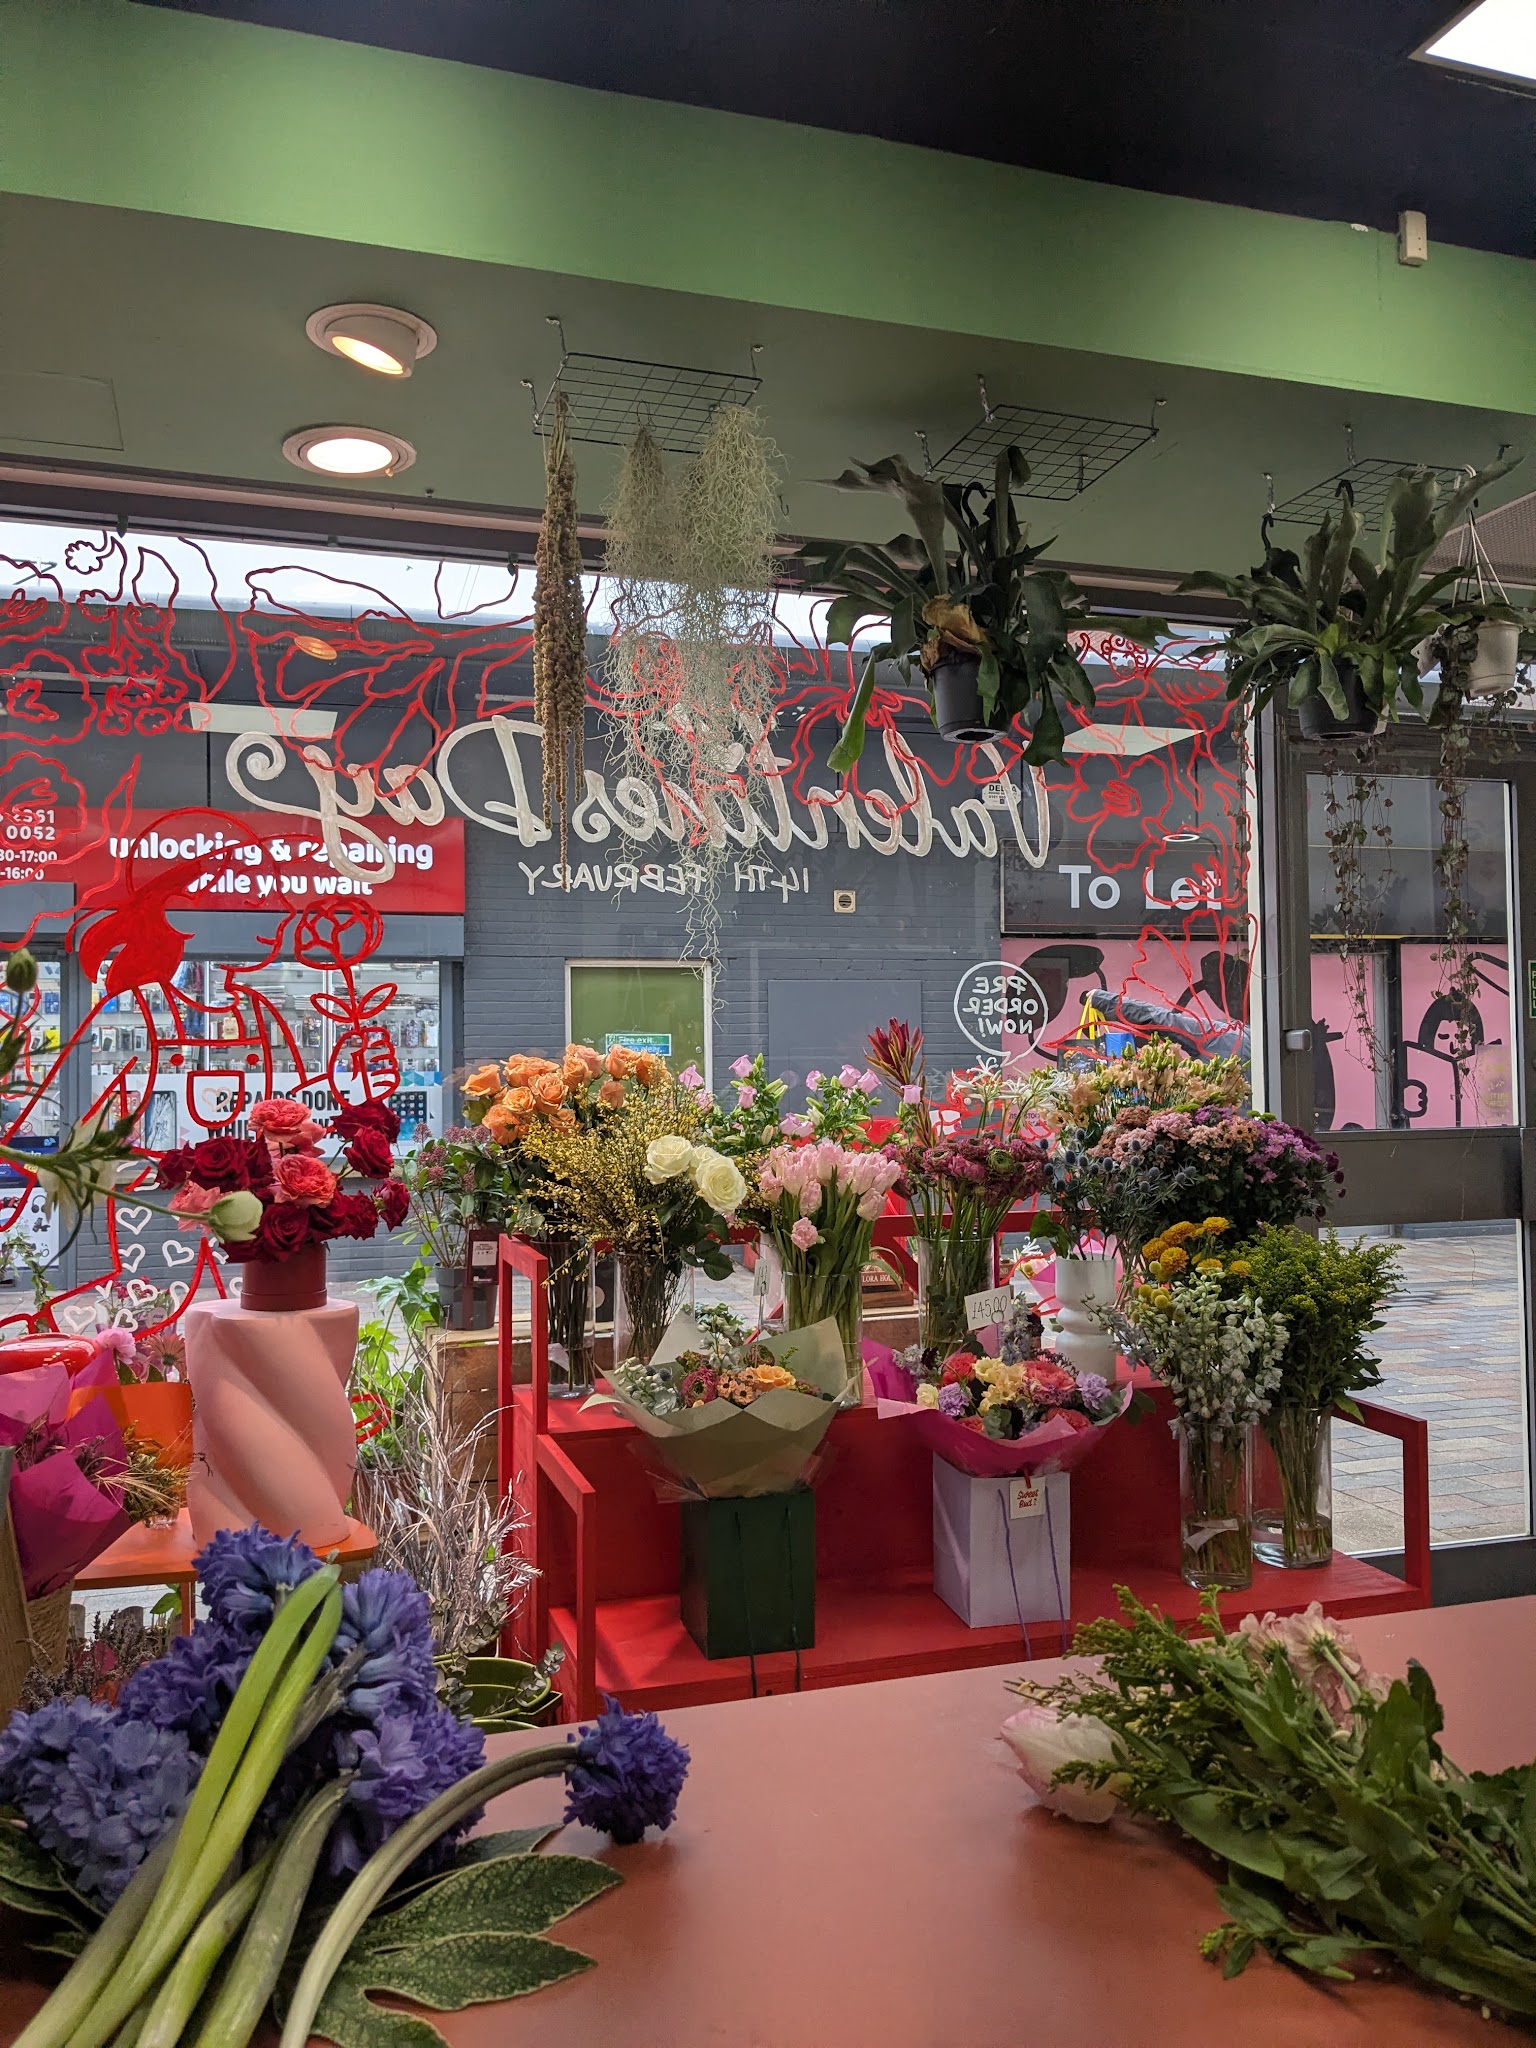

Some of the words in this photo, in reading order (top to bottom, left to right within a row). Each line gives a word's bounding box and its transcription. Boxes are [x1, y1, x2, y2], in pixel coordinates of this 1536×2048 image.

[6, 825, 56, 840] 0052
[270, 839, 292, 862] &
[1059, 864, 1121, 909] To
[1145, 867, 1222, 911] Let
